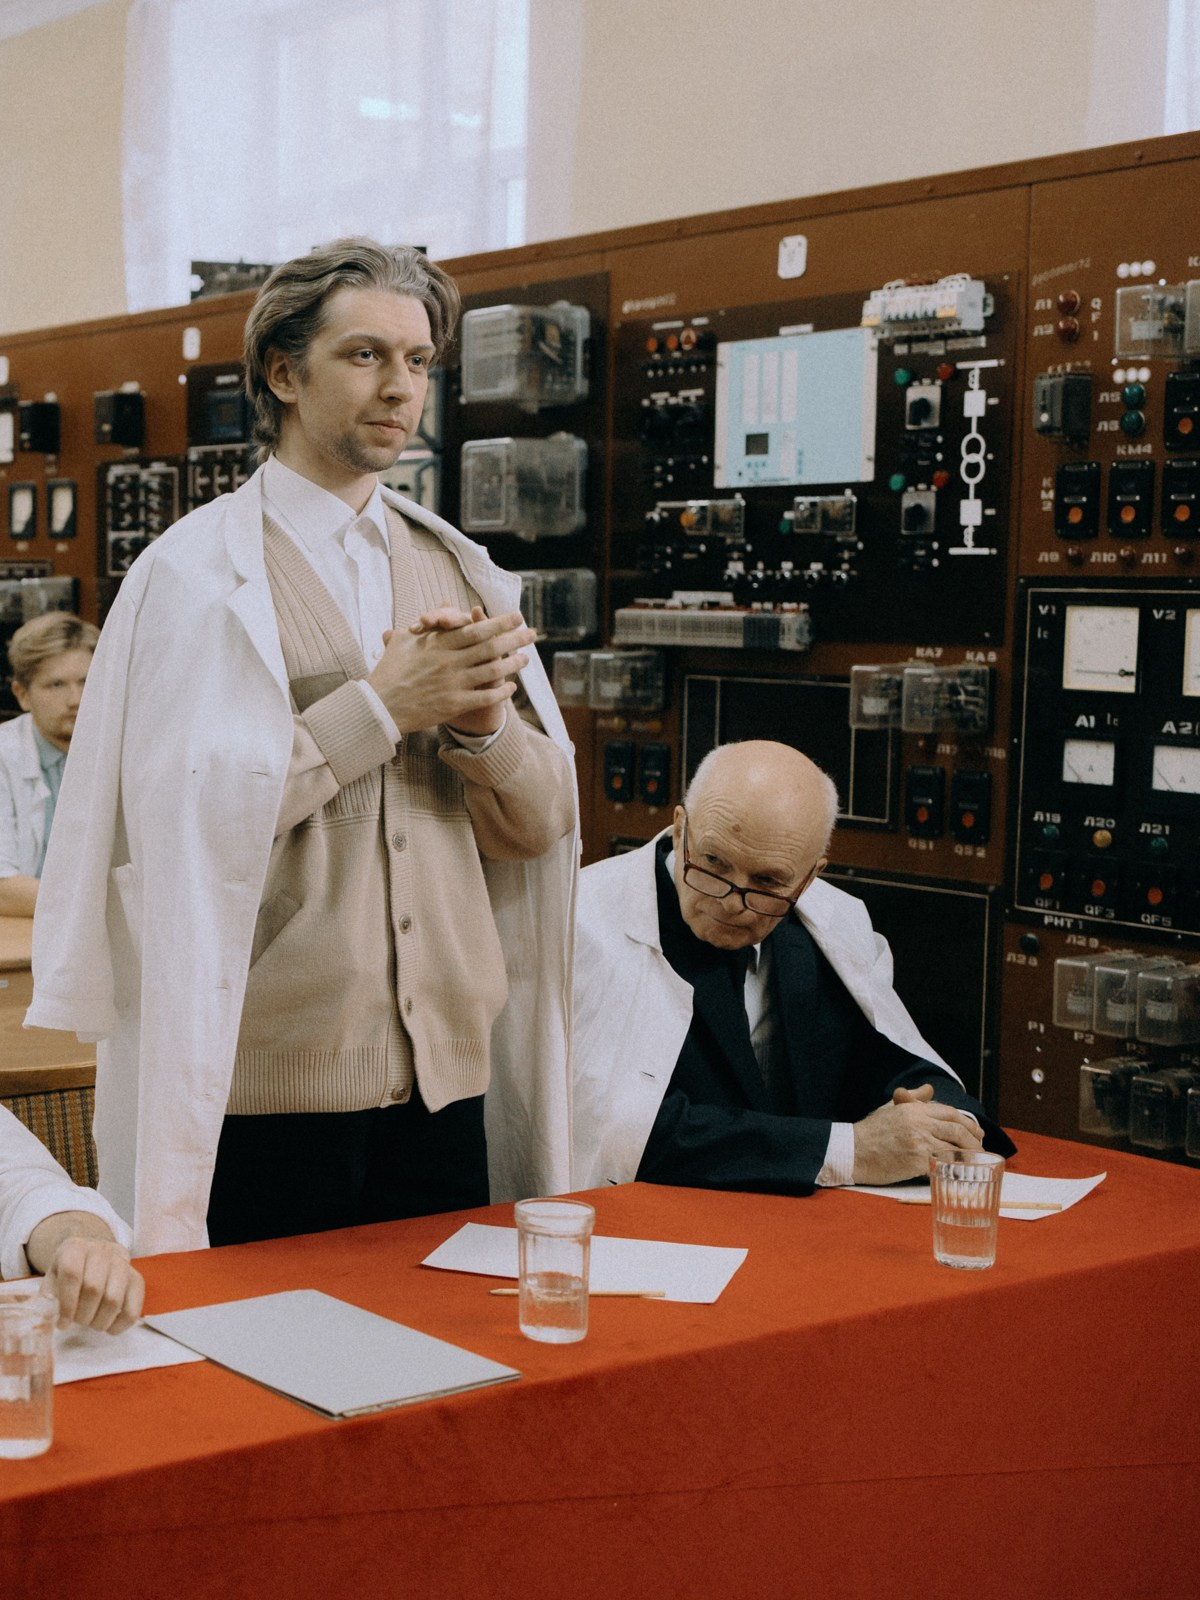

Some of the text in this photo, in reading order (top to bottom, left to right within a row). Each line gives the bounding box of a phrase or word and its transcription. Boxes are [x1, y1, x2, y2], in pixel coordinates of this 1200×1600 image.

[1038, 604, 1056, 615] V1
[1152, 609, 1176, 620] V2
[1075, 714, 1096, 728] A1
[1161, 720, 1193, 735] A2
[1083, 816, 1116, 829] Л20
[1139, 822, 1170, 835] Л21
